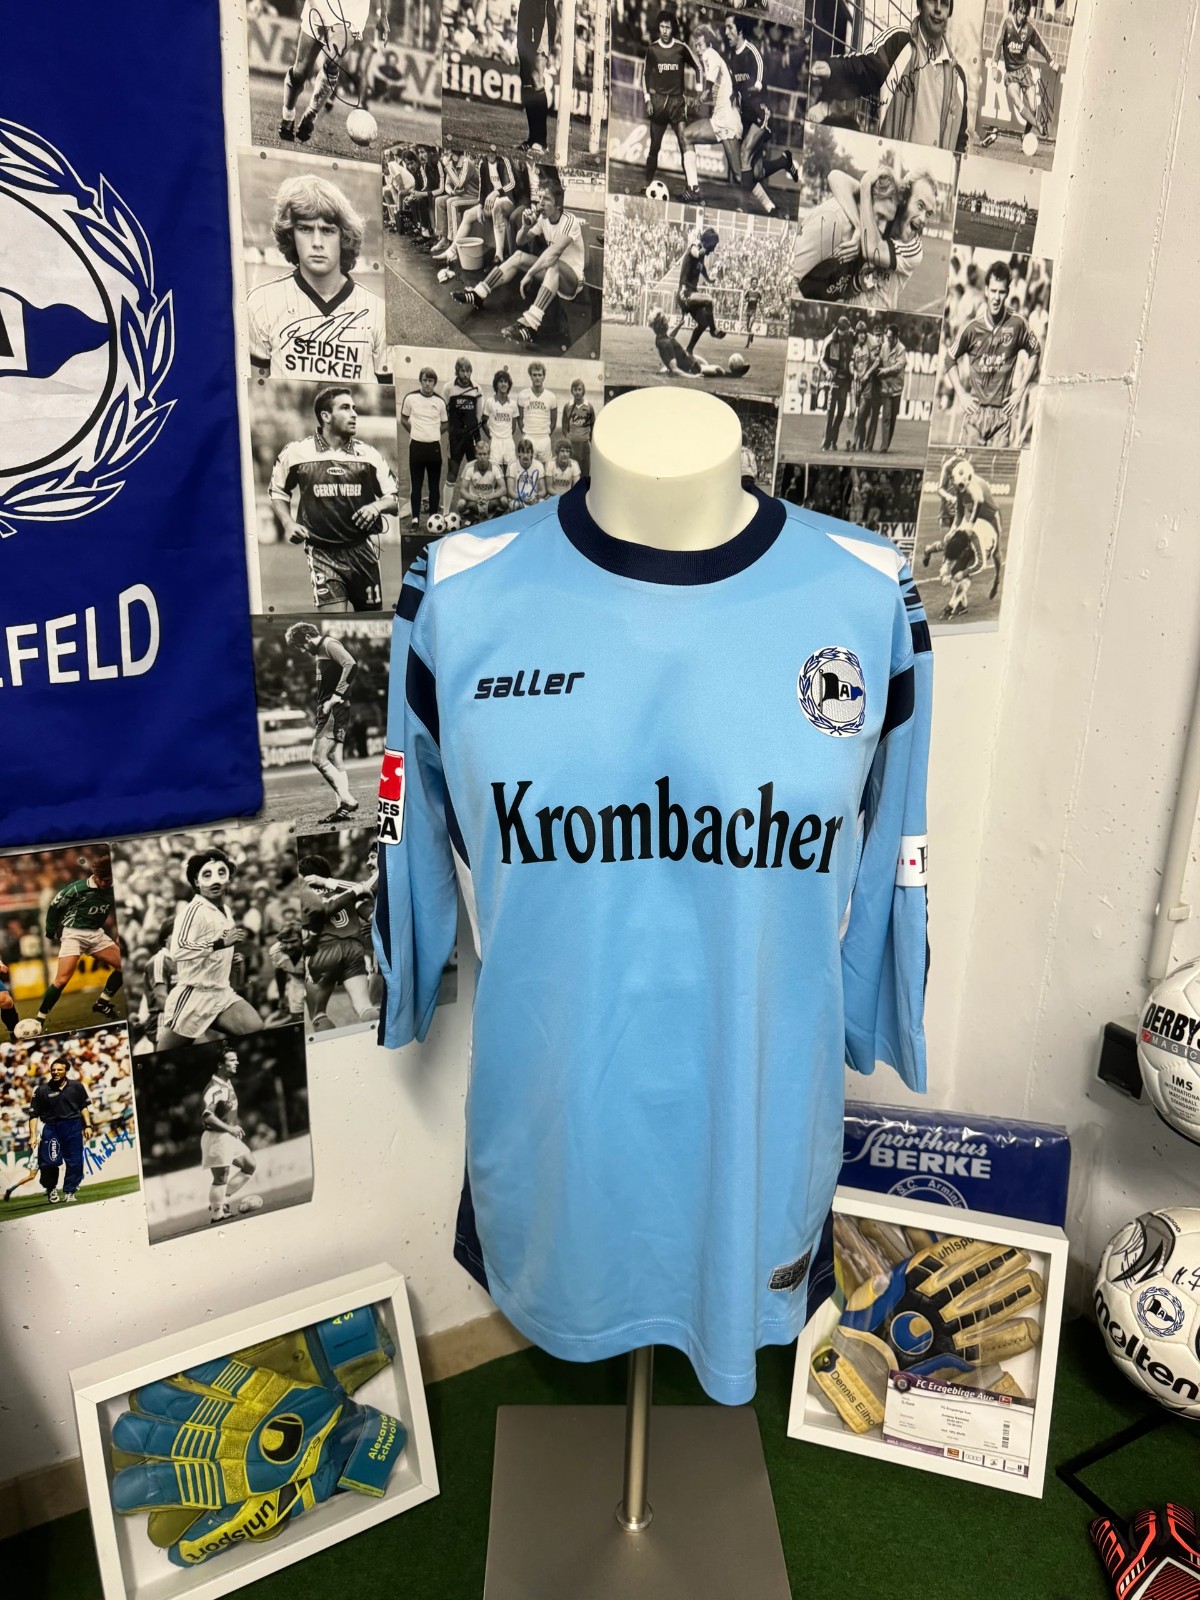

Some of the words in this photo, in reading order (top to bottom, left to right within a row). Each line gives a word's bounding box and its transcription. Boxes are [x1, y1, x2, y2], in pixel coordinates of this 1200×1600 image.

[293, 337, 359, 363] SEIDEN
[285, 354, 363, 379] STICKER
[313, 483, 338, 498] GERRY
[339, 483, 362, 497] WEBER
[366, 583, 382, 605] 11
[0, 583, 160, 688] FELD
[474, 669, 585, 700] saller
[839, 684, 850, 698] A
[490, 775, 844, 873] Krombacher
[1142, 1002, 1200, 1050] DERBY
[1151, 1034, 1198, 1061] MAGIC
[1164, 1081, 1200, 1100] INTERNATIONA
[1171, 1074, 1193, 1092] IMS
[869, 1145, 992, 1180] BERKE
[1095, 1288, 1199, 1401] molten
[831, 1370, 857, 1404] Dennis
[915, 1379, 926, 1390] FC
[928, 1381, 976, 1398] Erzgebirge
[977, 1391, 995, 1401] Aue
[368, 1412, 389, 1460] Alexand
[186, 1499, 276, 1562] uhlsport
